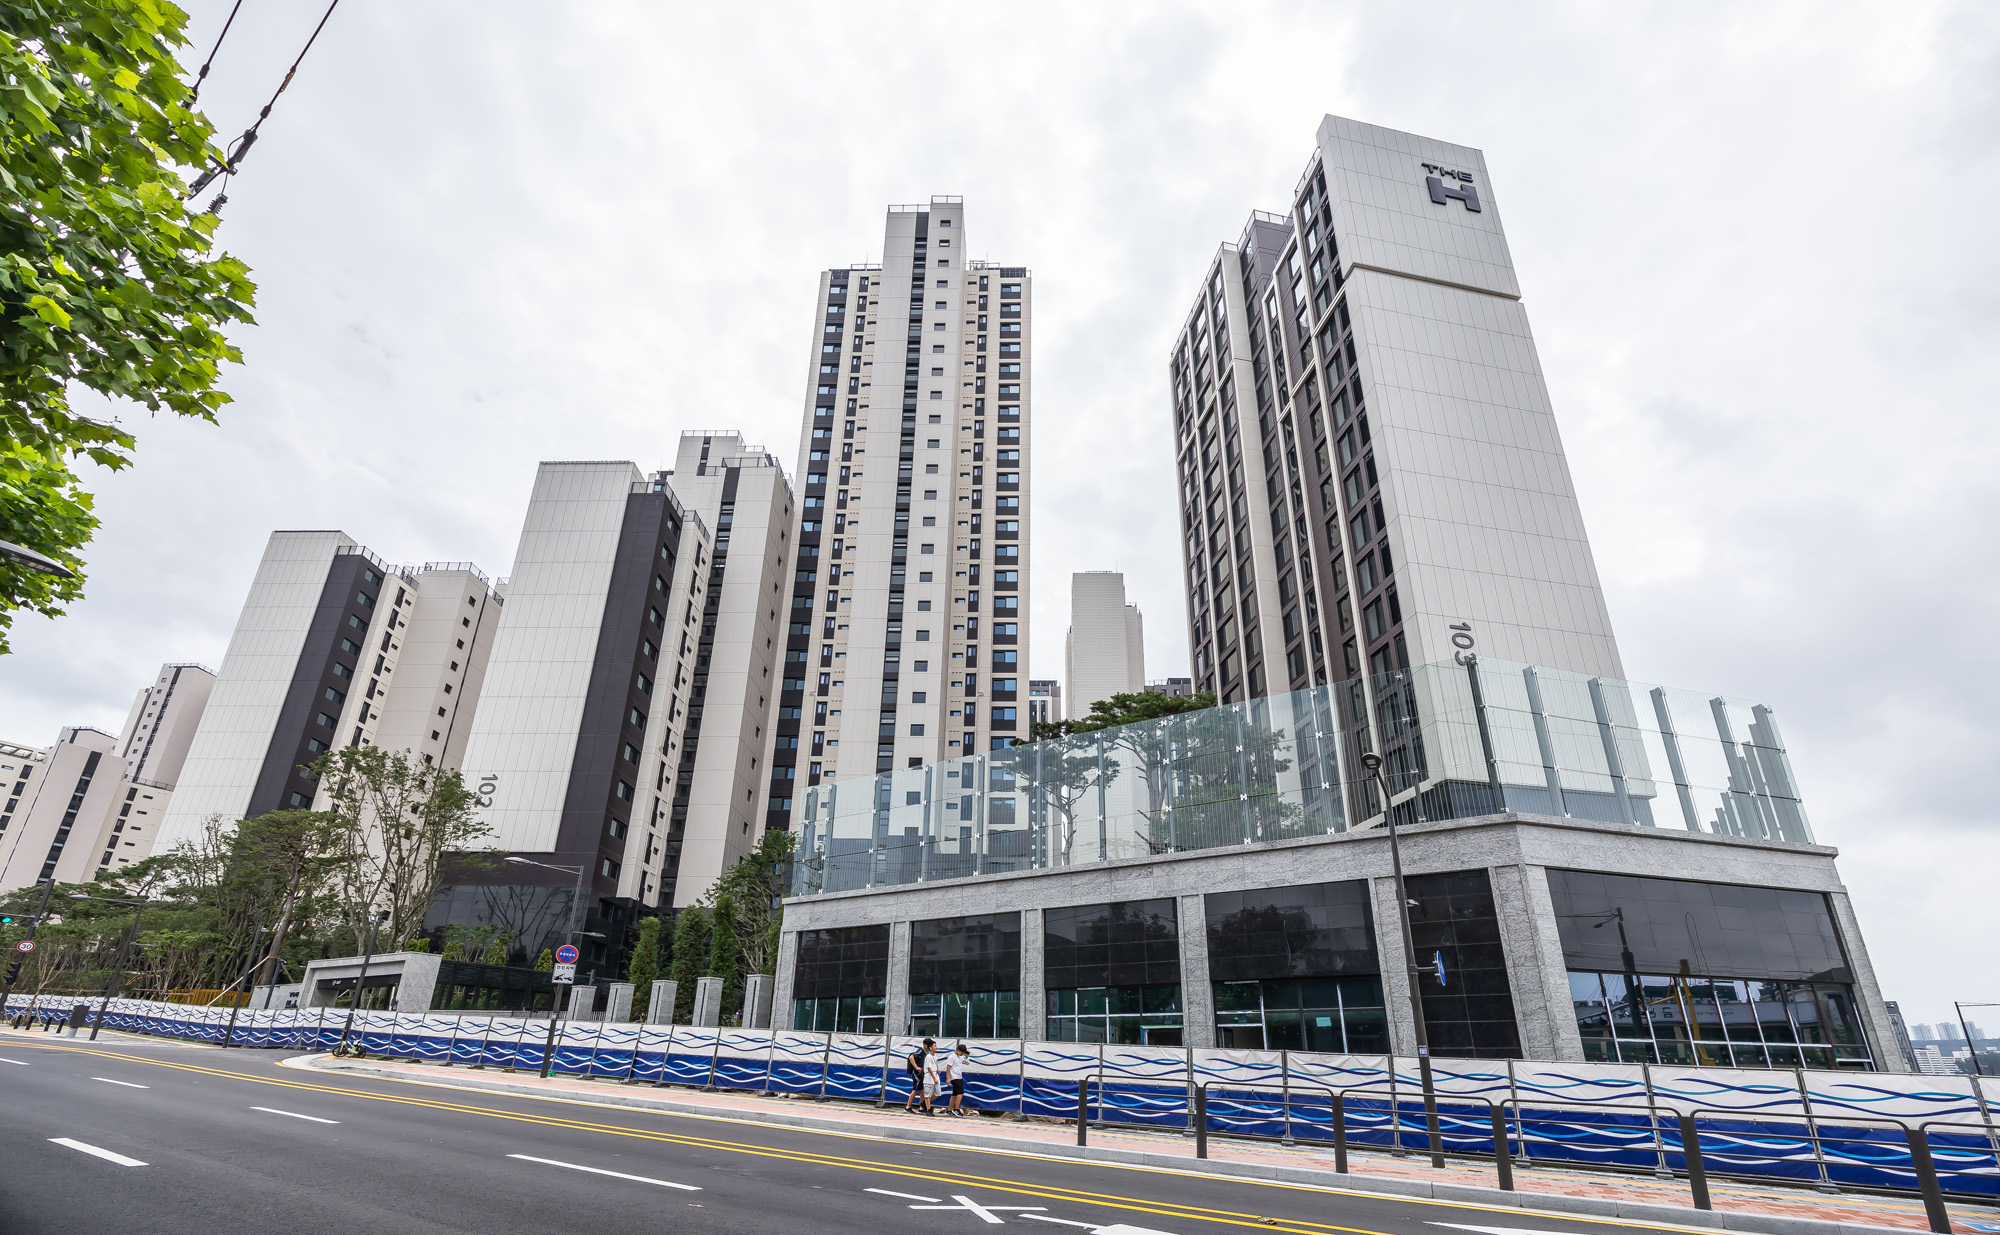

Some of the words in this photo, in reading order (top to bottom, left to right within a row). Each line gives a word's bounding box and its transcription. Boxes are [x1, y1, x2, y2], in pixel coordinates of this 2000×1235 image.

[1421, 162, 1473, 183] THE
[1426, 176, 1481, 213] H
[1449, 622, 1476, 666] 103
